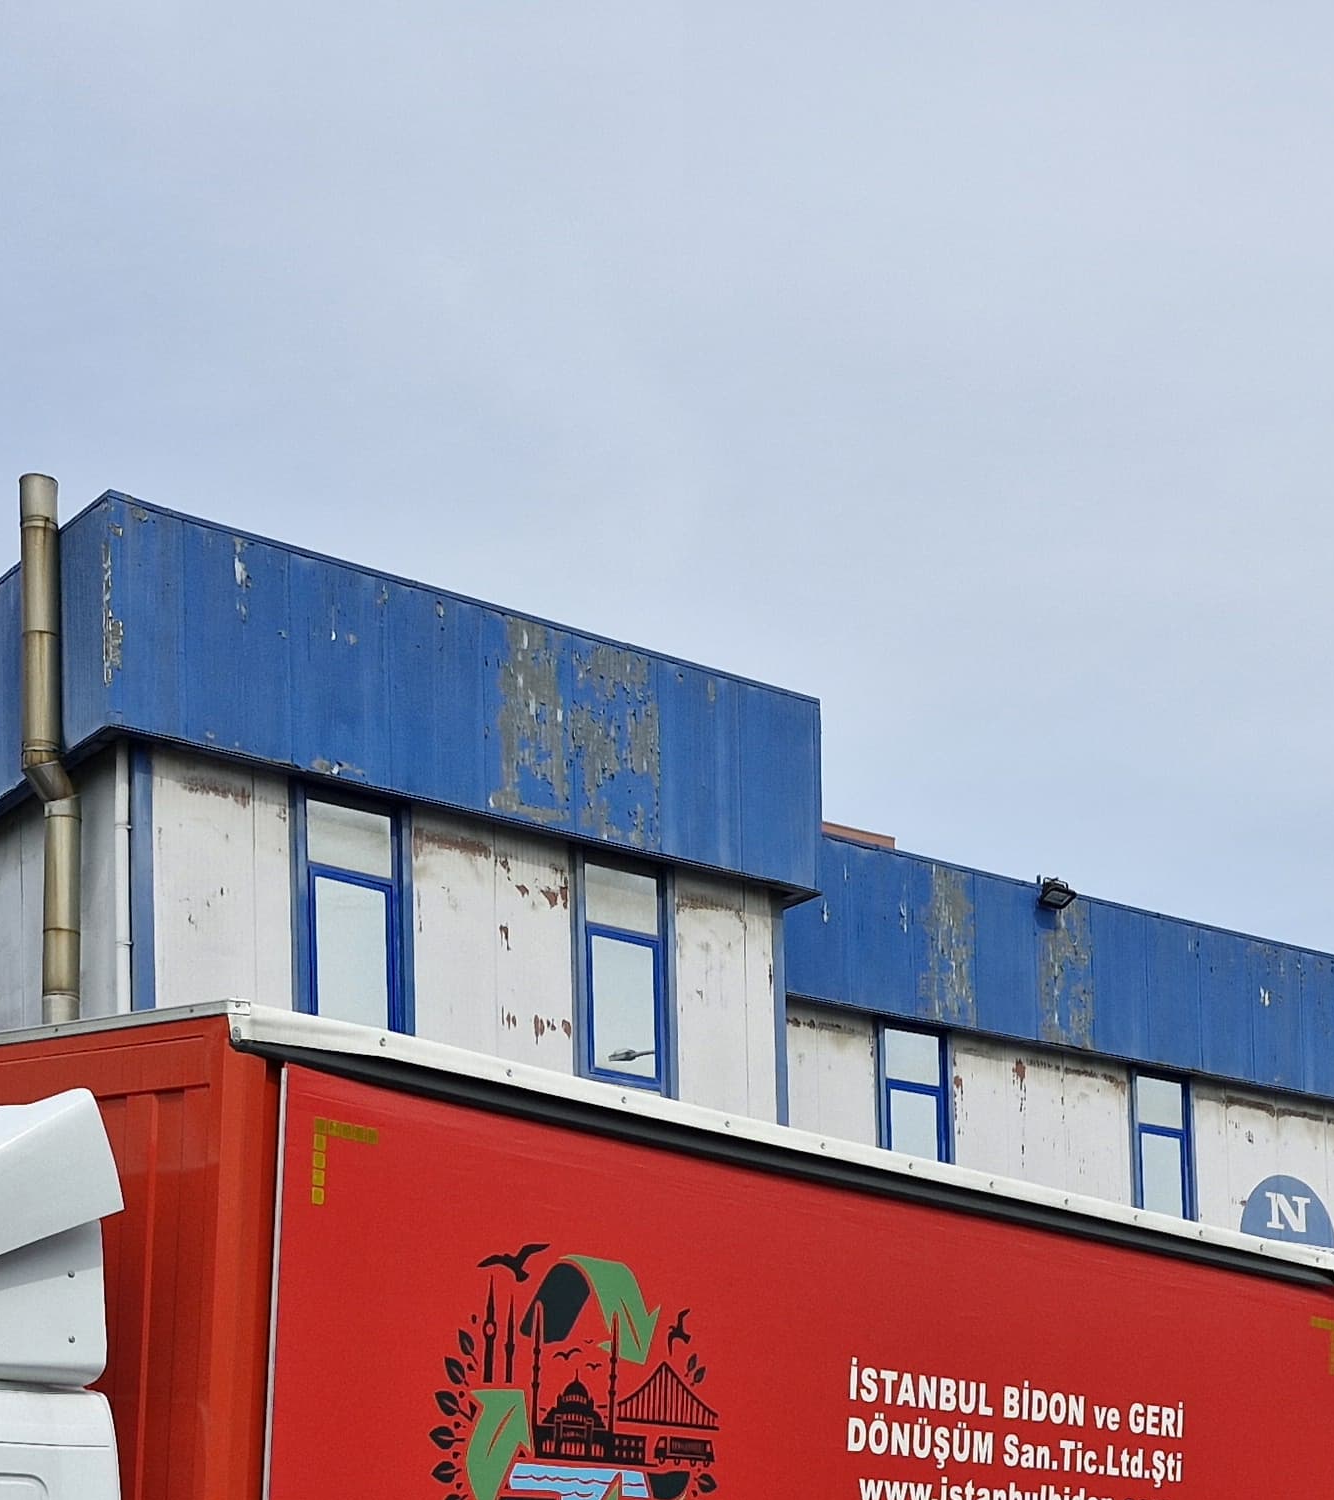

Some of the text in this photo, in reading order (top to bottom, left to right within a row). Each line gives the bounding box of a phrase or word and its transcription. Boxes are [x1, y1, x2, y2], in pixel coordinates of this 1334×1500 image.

[1265, 1191, 1311, 1233] N
[849, 1356, 1184, 1438] İSTANBUL BİDON ve GERİ
[847, 1412, 1183, 1488] DÖNÜŞÜM San.Tic.Ltd.Şti
